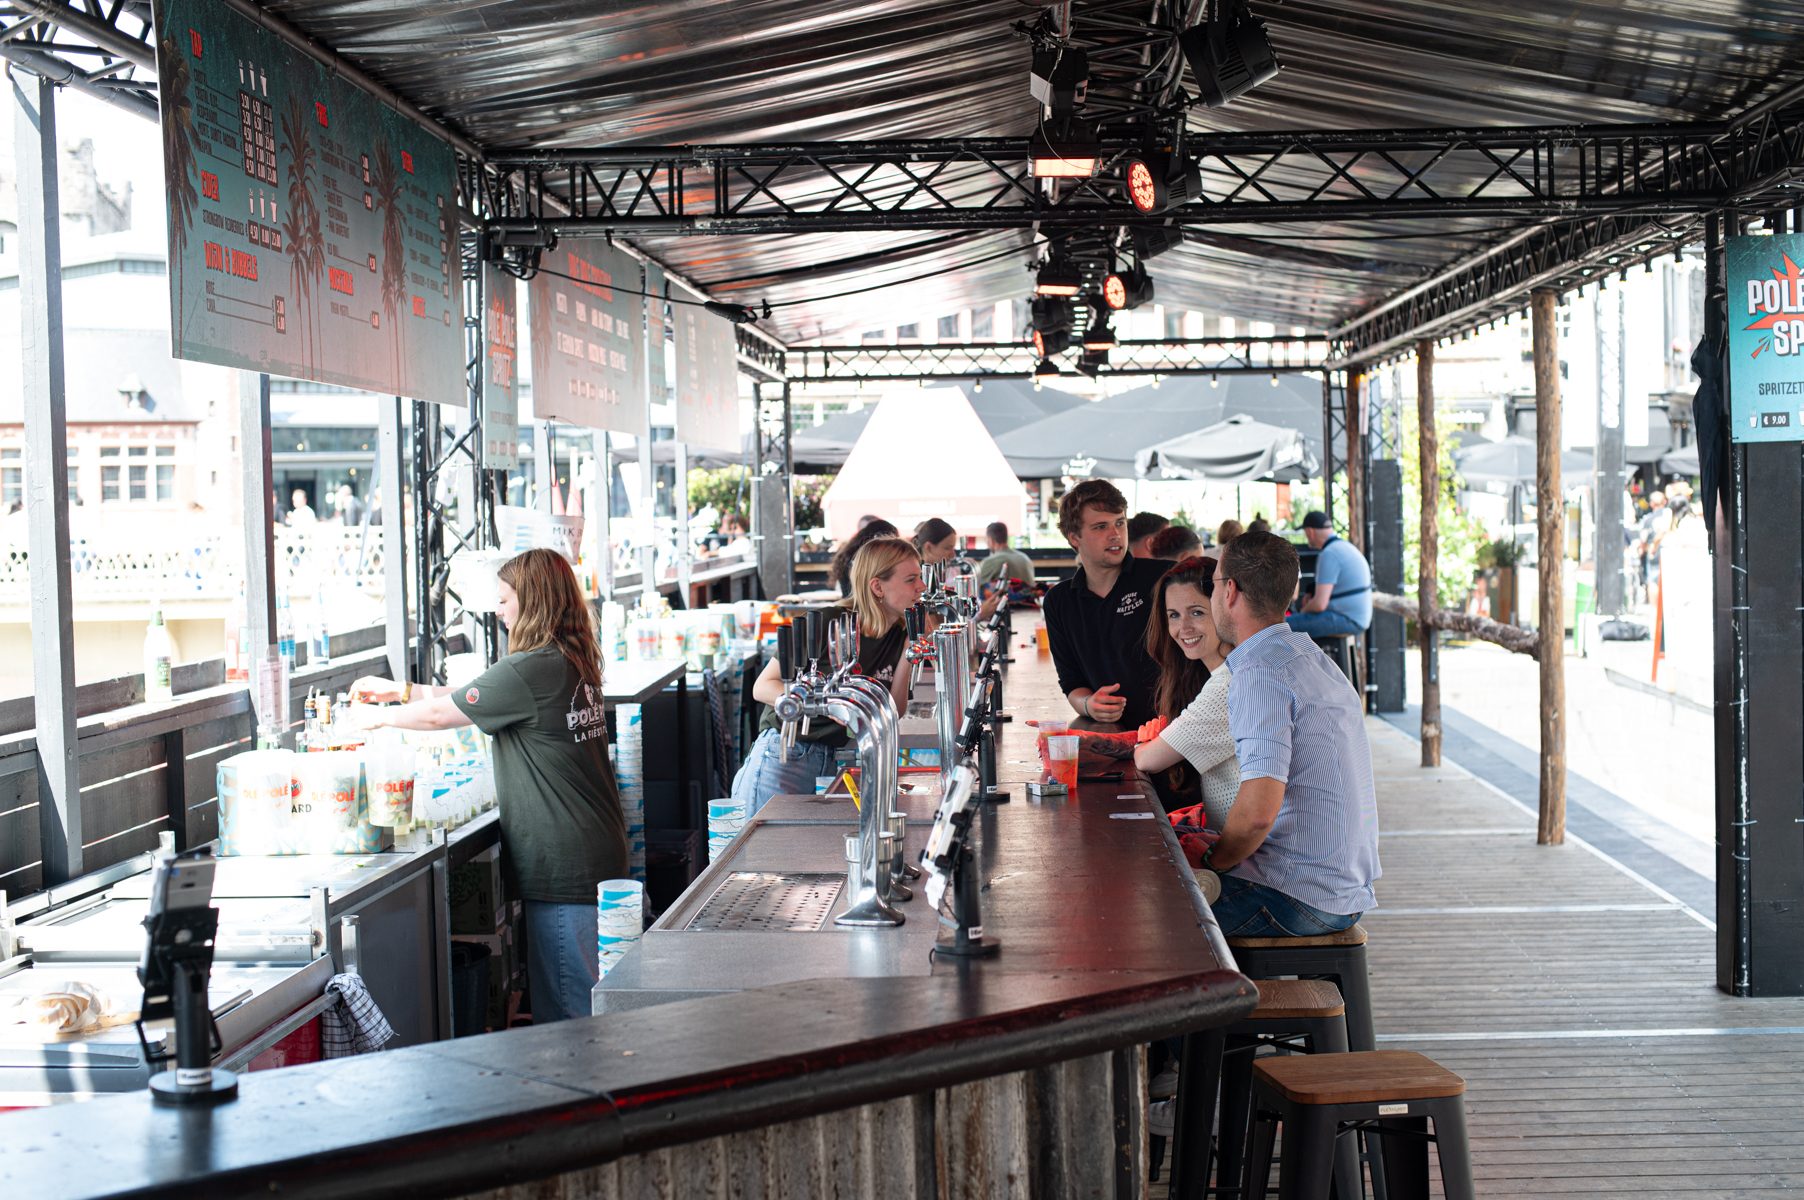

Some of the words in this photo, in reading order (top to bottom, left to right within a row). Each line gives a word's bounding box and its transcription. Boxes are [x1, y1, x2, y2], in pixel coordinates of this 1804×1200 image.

[189, 28, 203, 60] TAP
[201, 169, 219, 202] CIDER
[203, 239, 223, 270] WIJN
[231, 248, 258, 281] BUBBELS
[1772, 415, 1786, 425] 9.00
[1116, 598, 1144, 613] WAFFLES
[574, 732, 587, 743] LA
[376, 779, 405, 793] POLÉ
